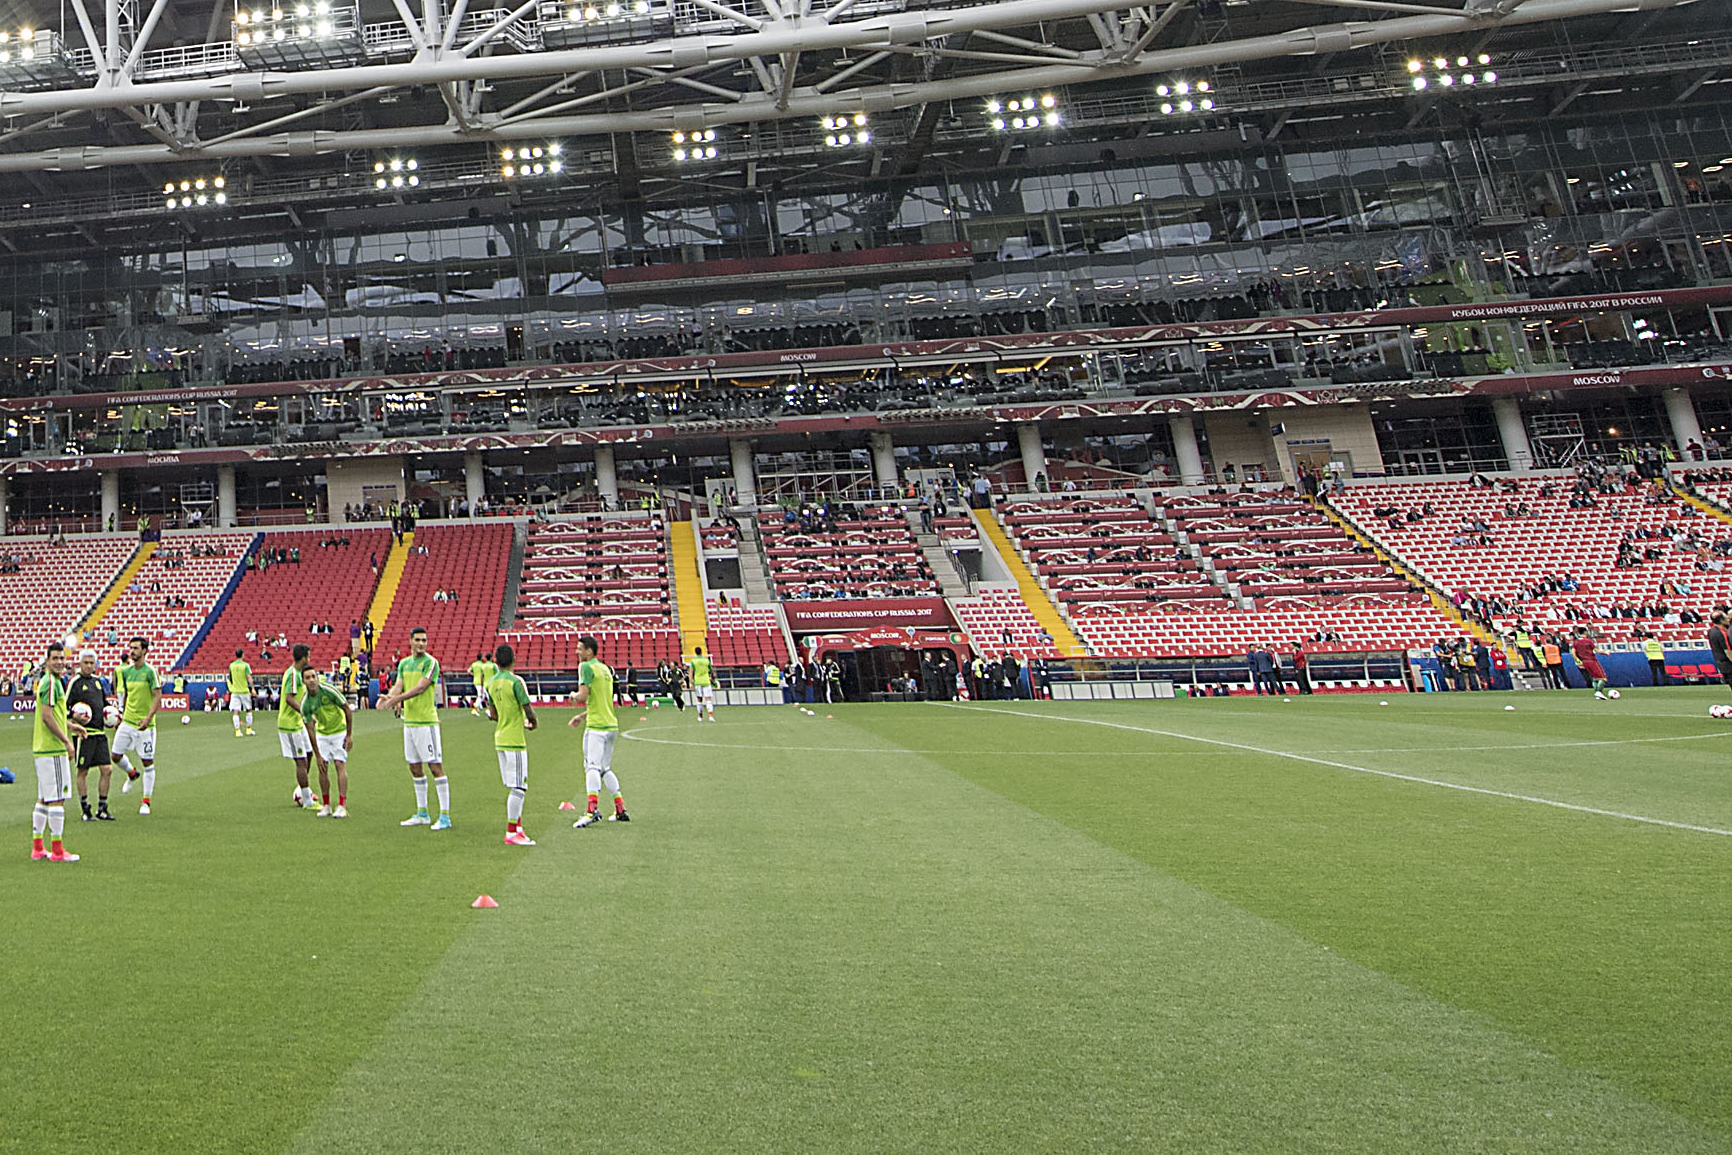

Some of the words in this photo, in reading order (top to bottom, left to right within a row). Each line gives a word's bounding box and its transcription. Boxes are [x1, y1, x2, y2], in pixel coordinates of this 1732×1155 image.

[1451, 308, 1485, 317] КУБОК
[1589, 300, 1610, 308] 2017
[780, 353, 817, 362] MOSCOW
[1573, 376, 1620, 385] MOSCOW
[143, 742, 153, 753] 23
